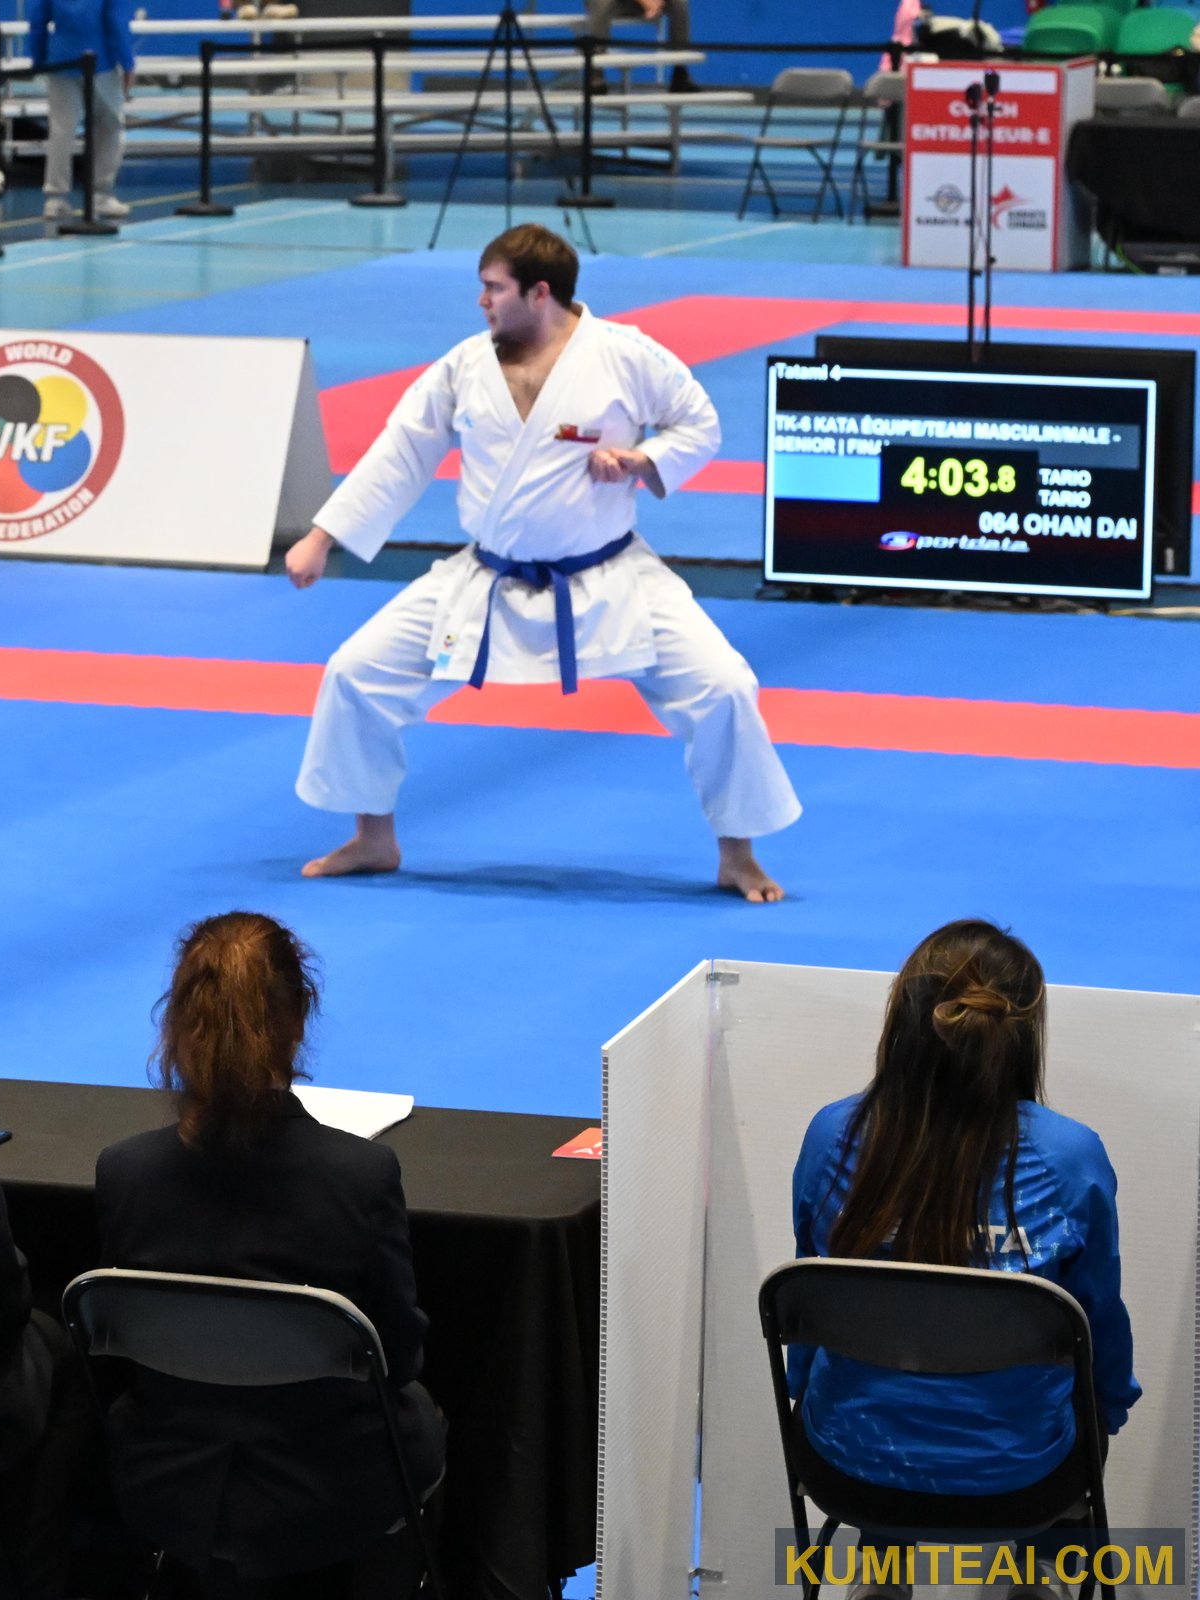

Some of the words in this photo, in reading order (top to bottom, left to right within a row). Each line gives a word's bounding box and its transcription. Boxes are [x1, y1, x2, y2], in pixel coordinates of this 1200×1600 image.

[4, 342, 73, 365] WORLD
[775, 362, 828, 381] Tatami
[829, 364, 842, 381] 4
[814, 415, 859, 434] KATA
[774, 435, 836, 454] SENIOR
[901, 456, 1016, 497] 4:03.8
[1023, 513, 1092, 538] OHAN
[1096, 516, 1137, 540] DAI
